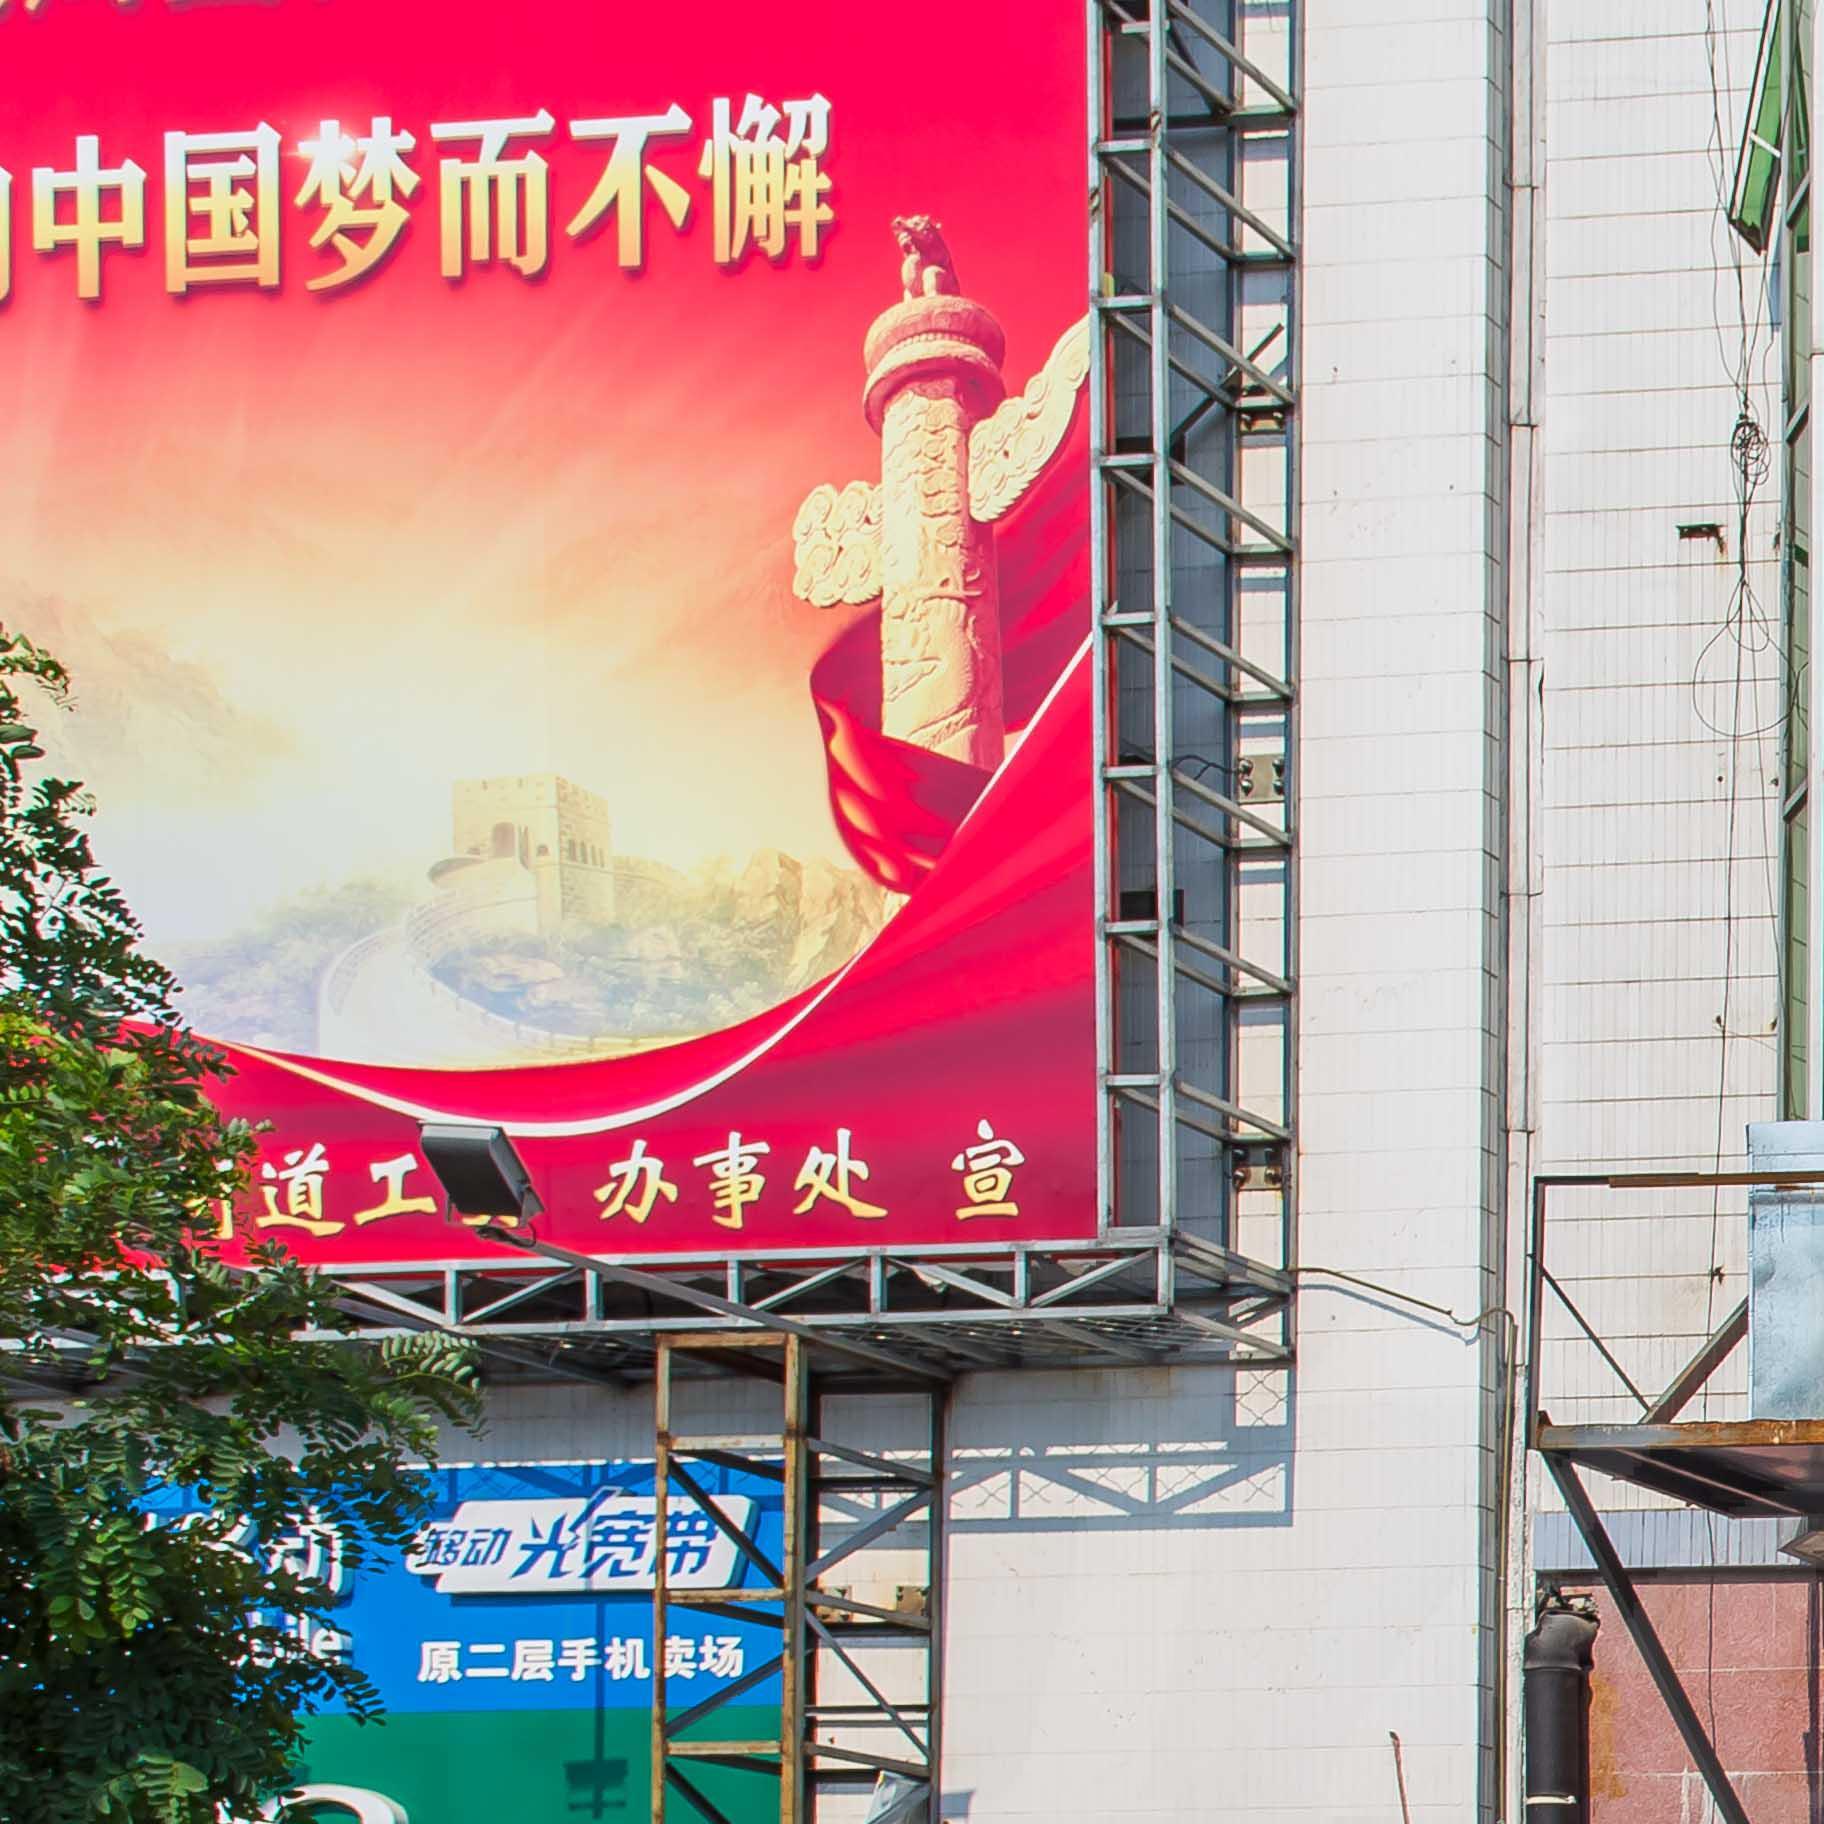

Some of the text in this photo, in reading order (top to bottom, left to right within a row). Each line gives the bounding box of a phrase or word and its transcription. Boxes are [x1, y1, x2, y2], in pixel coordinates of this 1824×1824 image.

[0, 93, 836, 300] 中国梦而不懈
[593, 1128, 888, 1228] 办事处
[952, 1119, 1027, 1218] 宣
[417, 1635, 745, 1684] 原二层手机卖场
